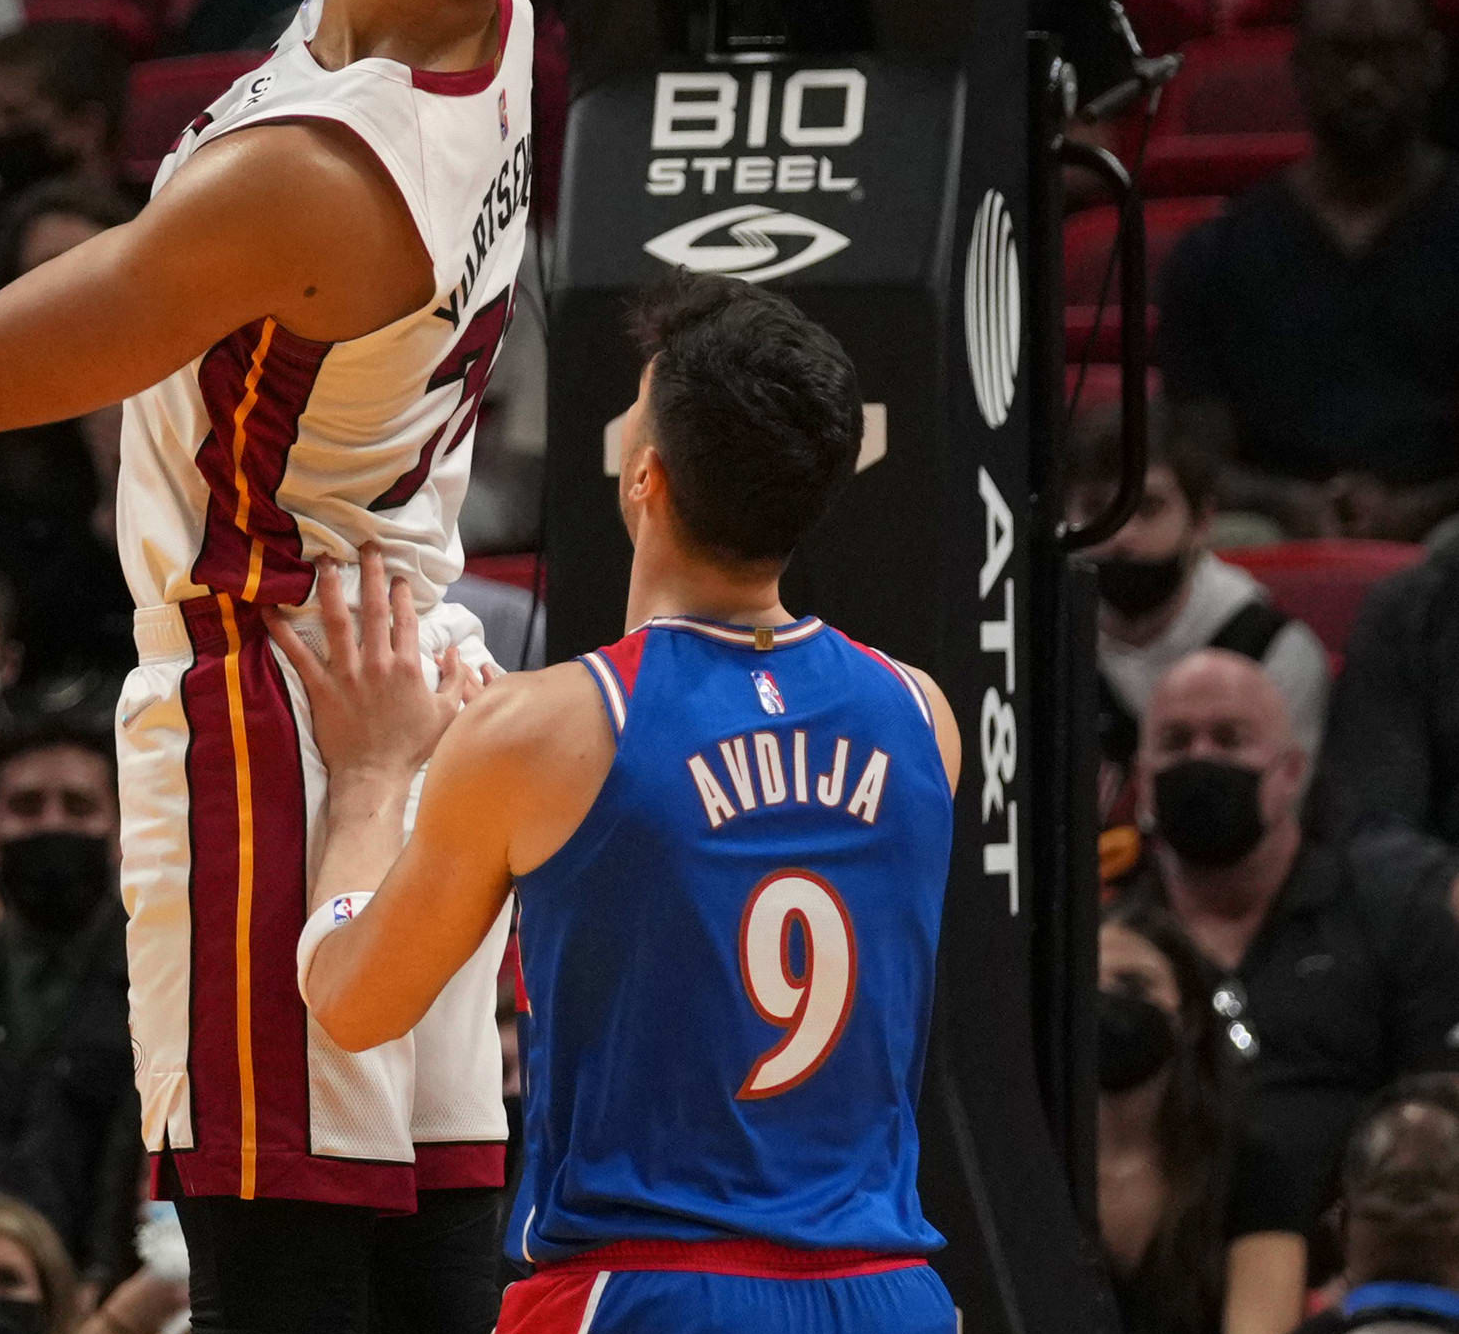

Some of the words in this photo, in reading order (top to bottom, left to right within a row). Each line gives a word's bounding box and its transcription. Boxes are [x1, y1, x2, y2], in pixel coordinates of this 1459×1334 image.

[651, 68, 868, 150] BIO
[645, 154, 859, 196] STEEL
[977, 465, 1019, 918] AT&T
[687, 729, 891, 830] AVDIJA
[734, 868, 859, 1101] 9
